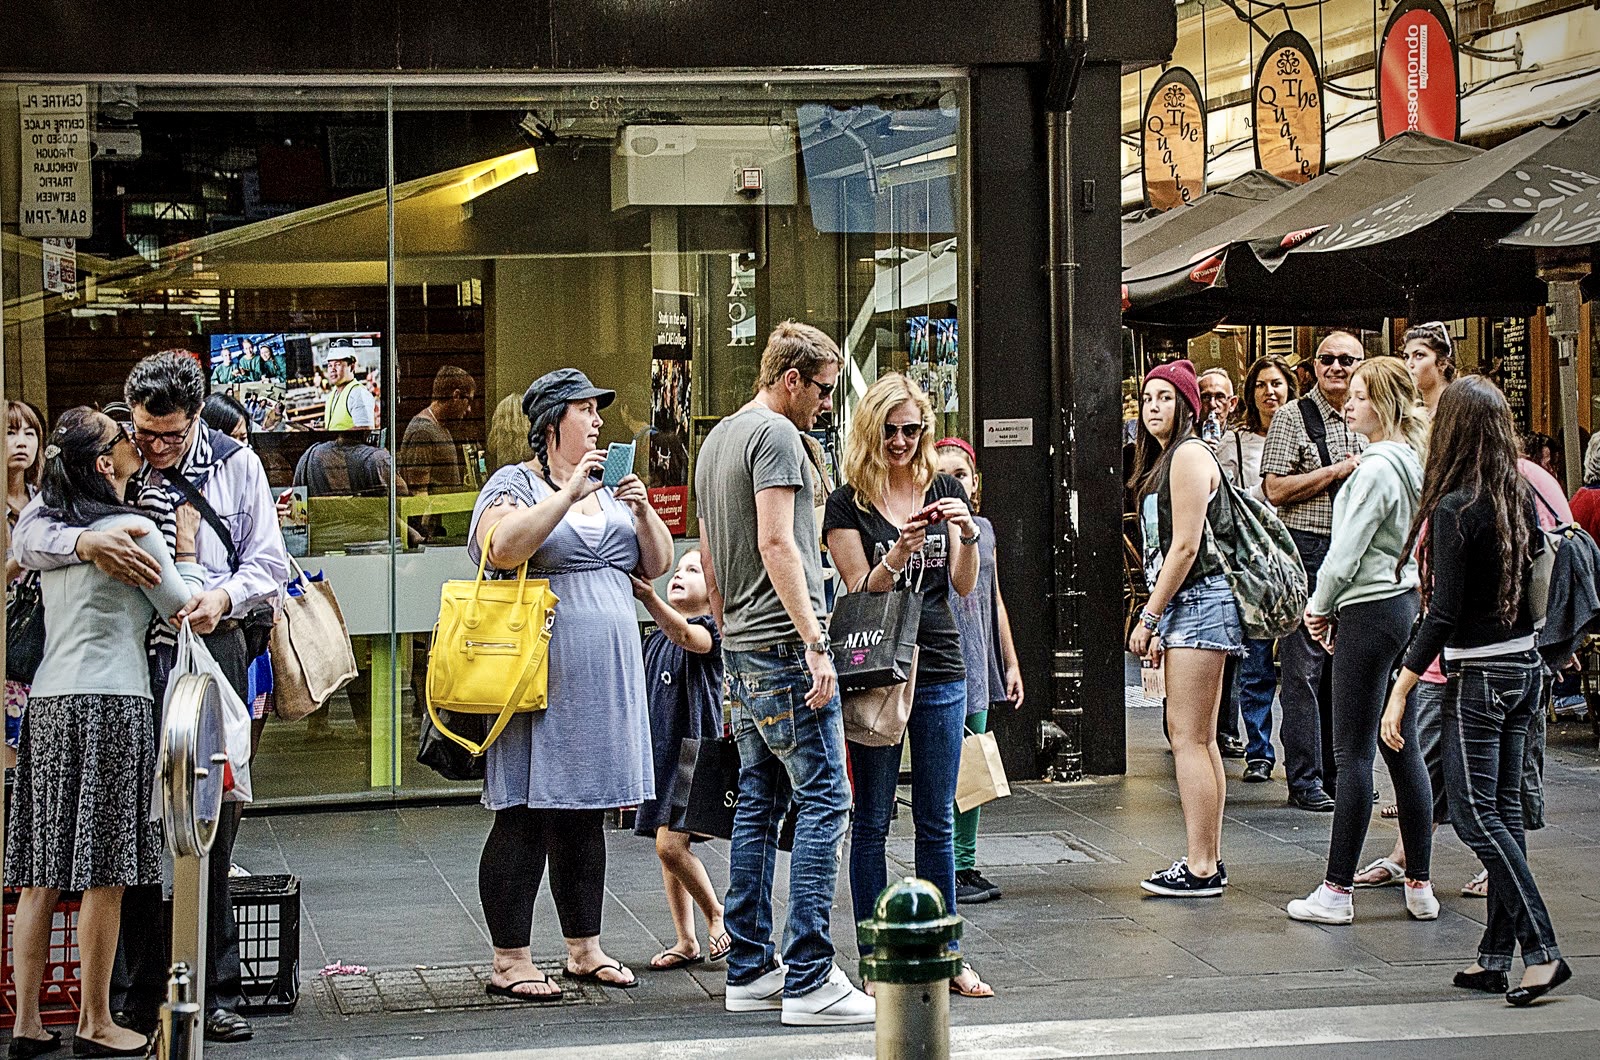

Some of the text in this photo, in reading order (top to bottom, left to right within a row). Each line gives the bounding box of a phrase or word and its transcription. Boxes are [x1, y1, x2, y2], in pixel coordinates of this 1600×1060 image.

[1282, 78, 1318, 111] The
[1167, 109, 1199, 142] The
[843, 629, 885, 649] MNG
